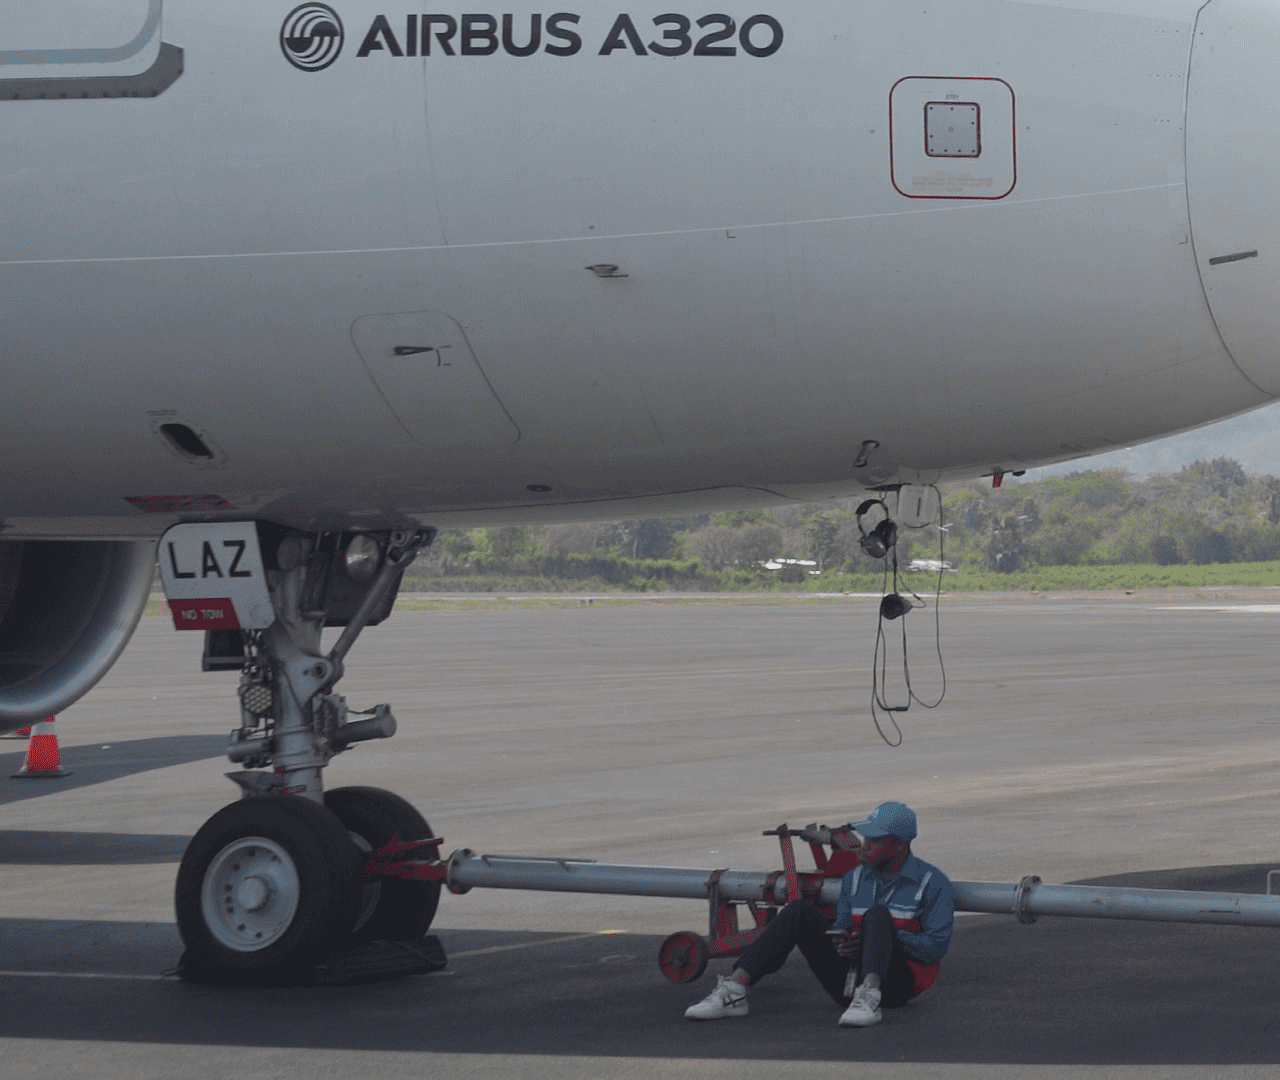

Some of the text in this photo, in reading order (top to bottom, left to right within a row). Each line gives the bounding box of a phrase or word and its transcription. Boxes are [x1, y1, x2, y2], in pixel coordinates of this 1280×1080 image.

[355, 13, 785, 58] AIRBUS A320
[167, 539, 252, 579] LAZ
[181, 609, 198, 620] NO
